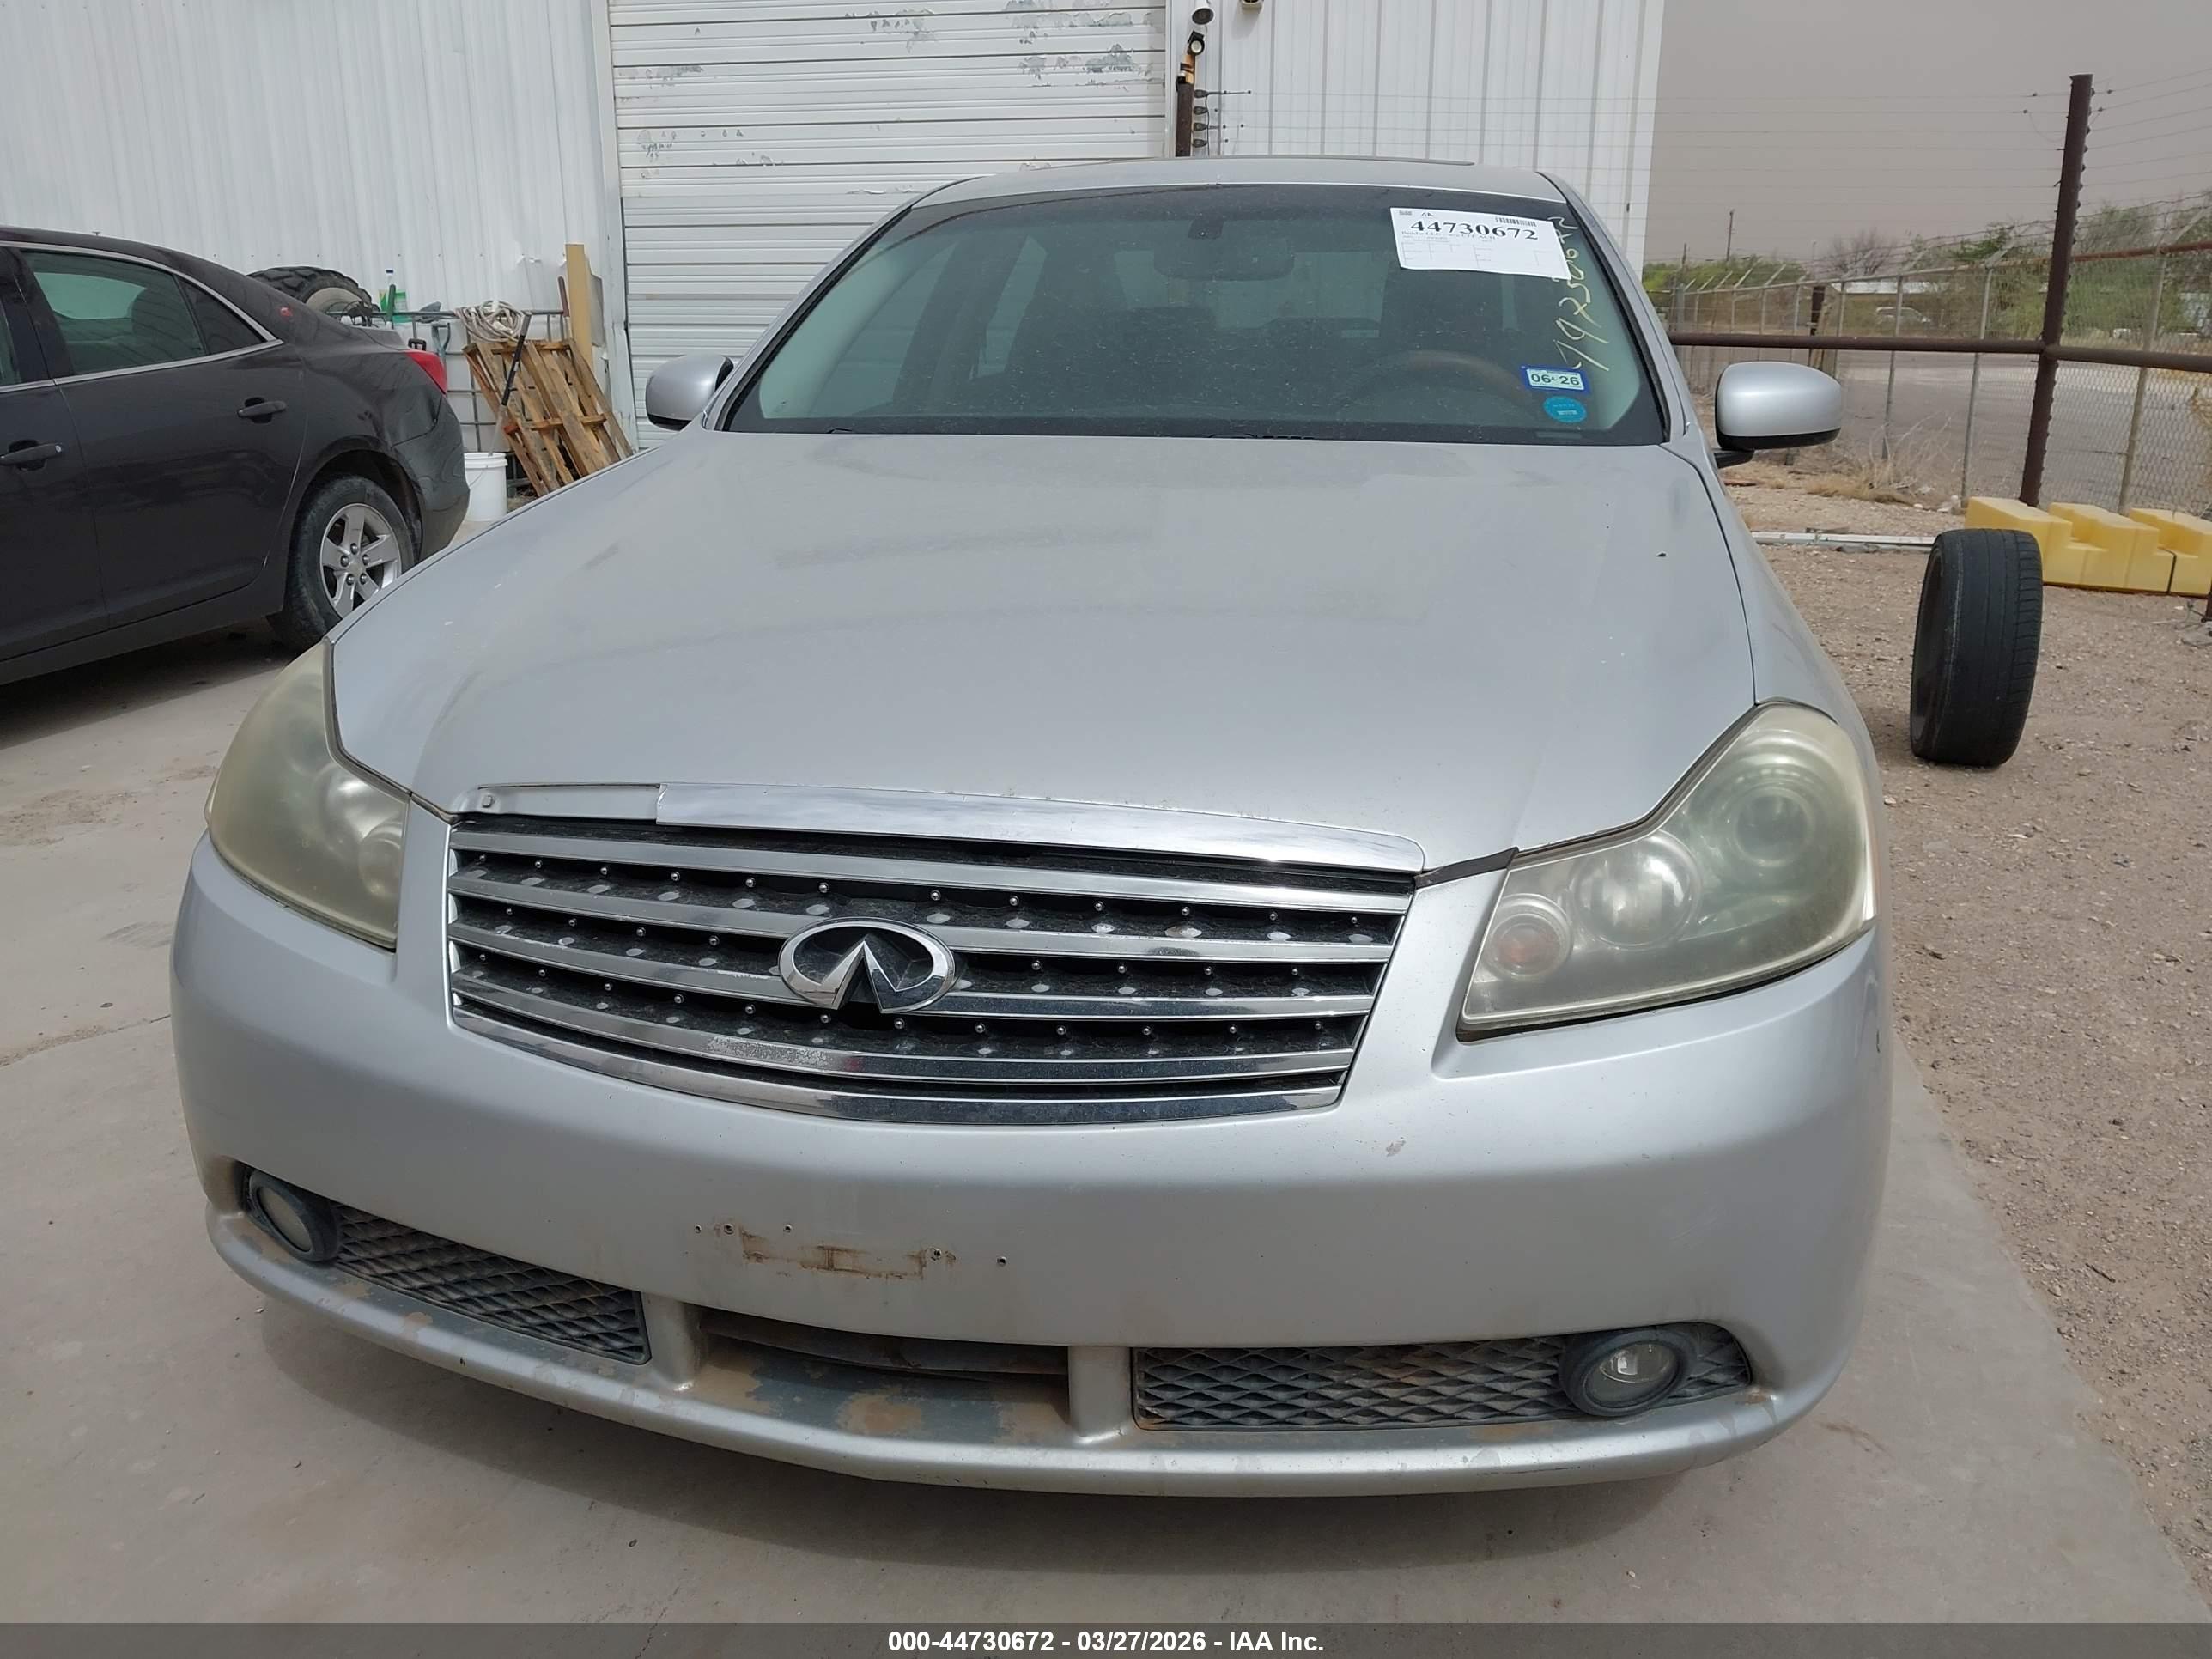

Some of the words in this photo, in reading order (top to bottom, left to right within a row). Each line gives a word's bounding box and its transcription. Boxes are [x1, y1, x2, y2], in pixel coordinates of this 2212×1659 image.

[1411, 221, 1538, 240] 44730672
[1530, 374, 1552, 384] 06
[1559, 375, 1580, 386] 26
